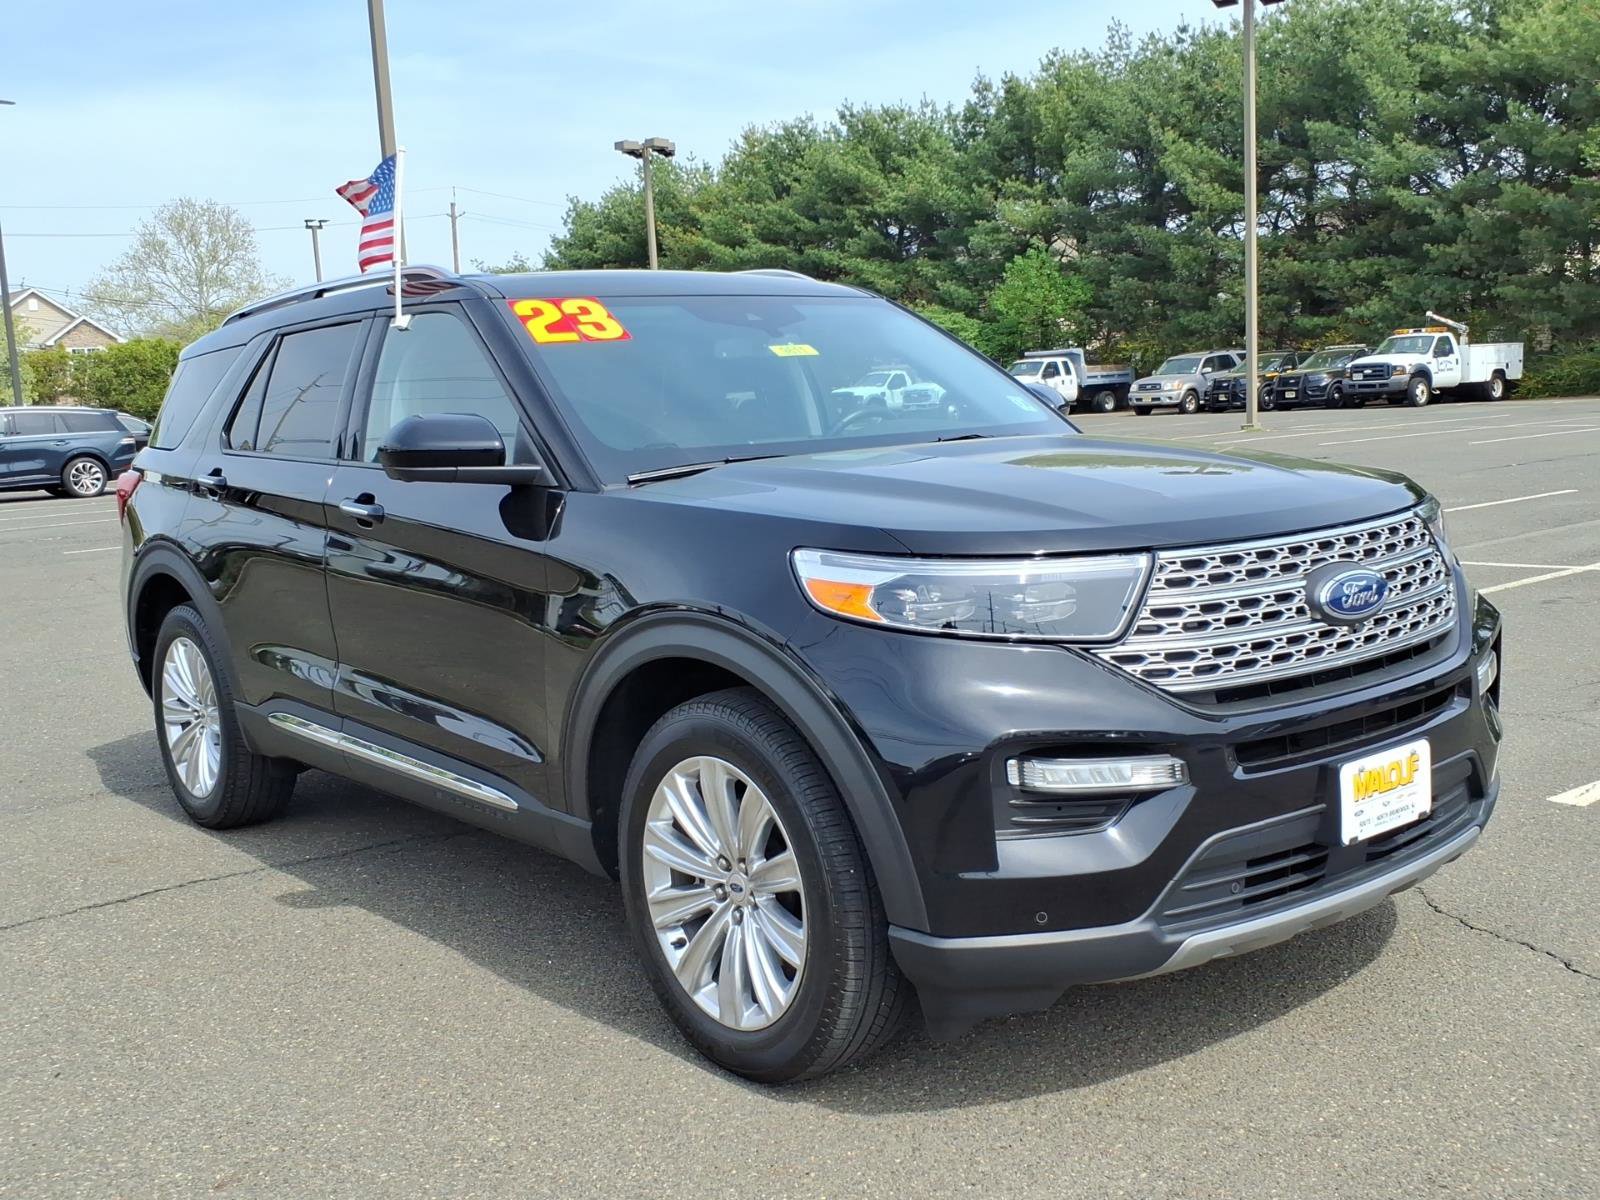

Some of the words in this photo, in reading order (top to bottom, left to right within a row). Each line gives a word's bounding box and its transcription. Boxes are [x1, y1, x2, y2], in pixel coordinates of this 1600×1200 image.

[513, 299, 624, 343] 23
[1342, 580, 1378, 609] Ford
[1353, 753, 1419, 803] MALOUF
